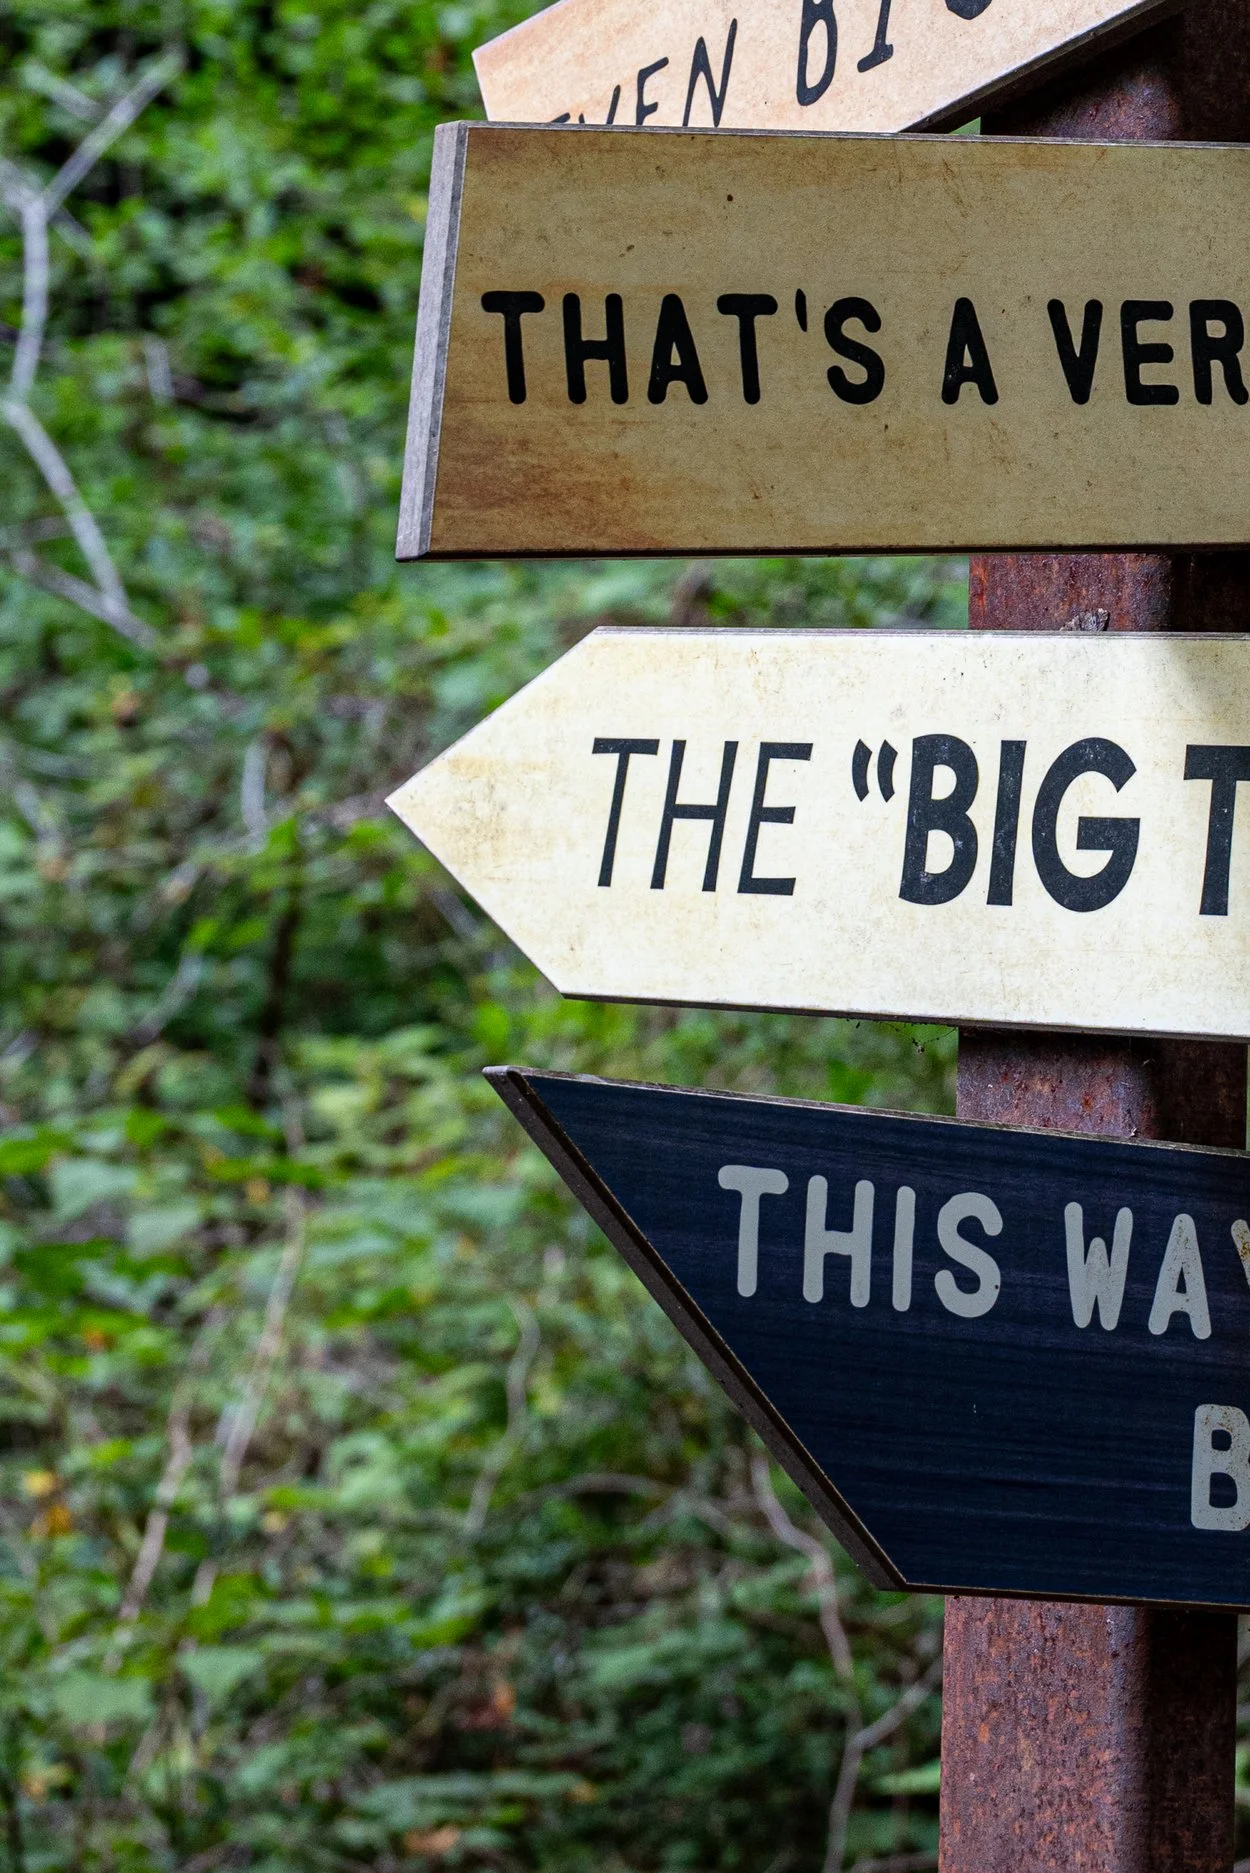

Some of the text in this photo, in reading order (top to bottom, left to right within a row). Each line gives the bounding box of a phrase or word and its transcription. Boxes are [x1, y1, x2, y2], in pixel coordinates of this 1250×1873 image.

[551, 17, 737, 127] EN
[481, 289, 885, 405] THAT'S
[942, 297, 998, 405] A
[592, 738, 813, 896] THE
[718, 1165, 1003, 1317] THIS
